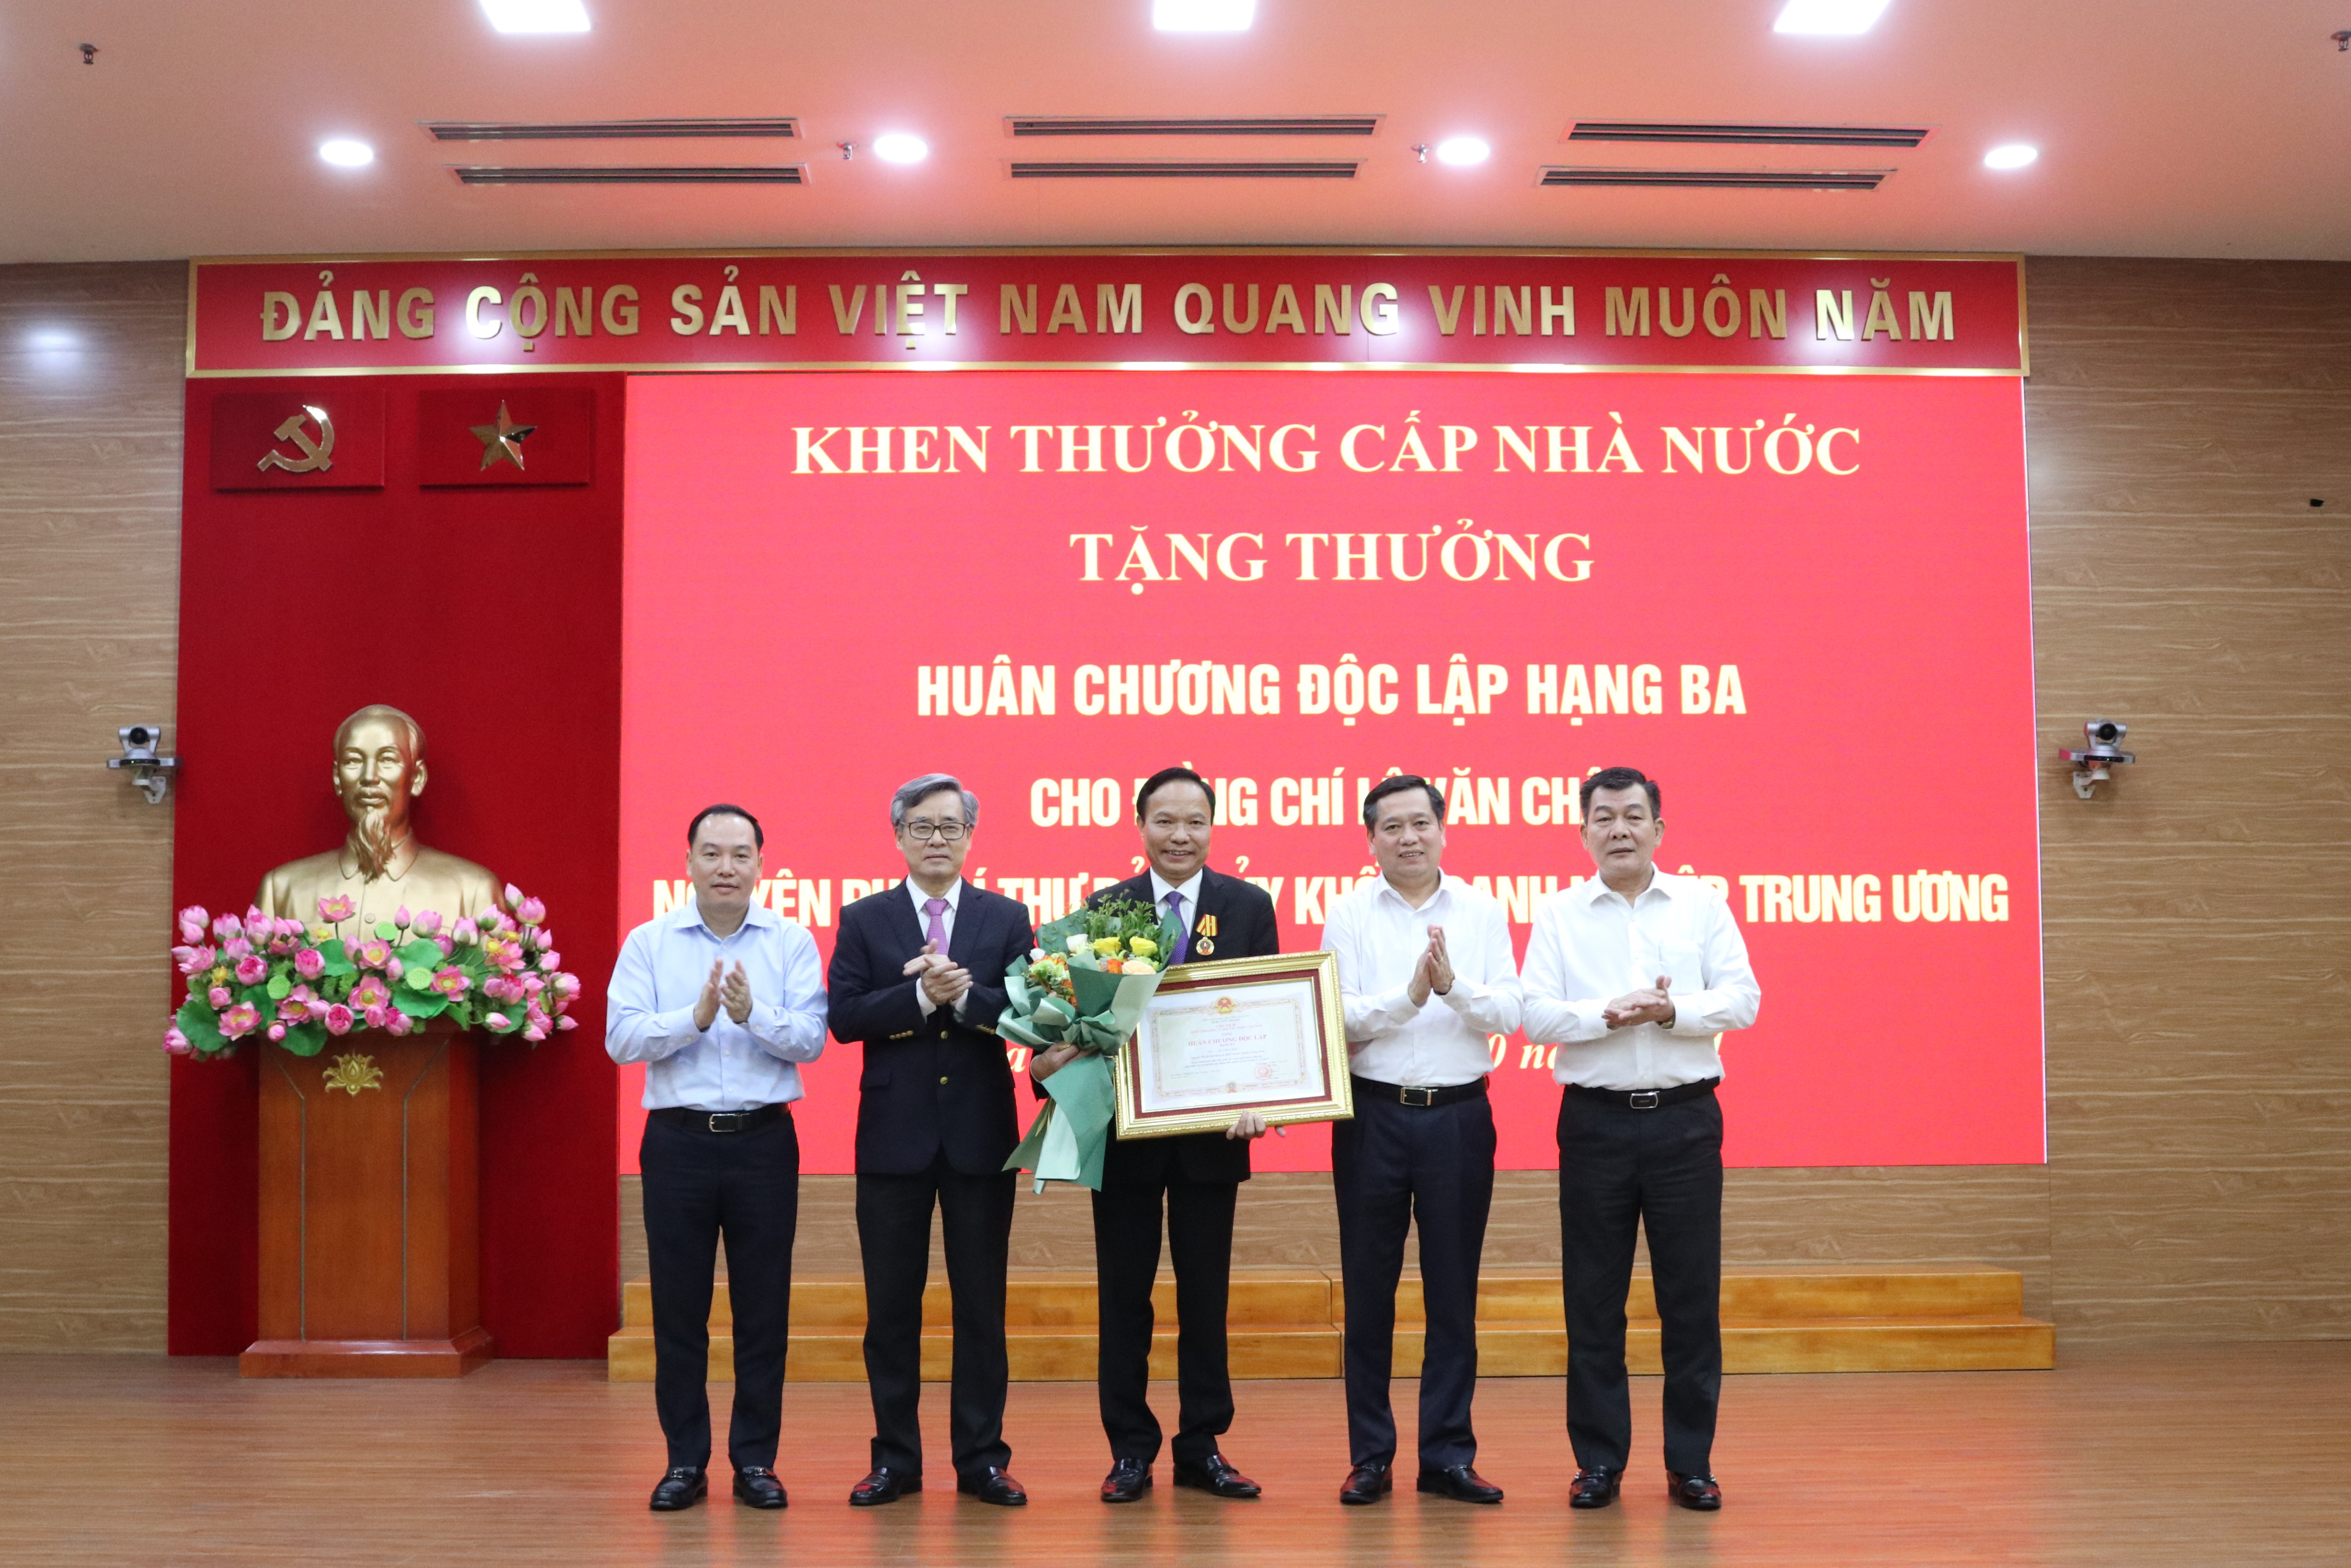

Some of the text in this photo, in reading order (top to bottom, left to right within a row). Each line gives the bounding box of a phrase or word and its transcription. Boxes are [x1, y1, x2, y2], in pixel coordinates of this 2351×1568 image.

[260, 265, 1954, 351] ĐẢNG CỘNG SẢN VIỆT NAM QUANG VINH MUÔN NĂM
[791, 410, 1859, 475] KHEN THƯỞNG CẤP NHÀ NƯỚC
[1070, 519, 1594, 595] TẶNG THƯỞNG
[918, 653, 1747, 726] HUÂN CHƯƠNG ĐỘC LẬP HẠNG BA
[1031, 778, 1121, 827] CHO
[1270, 767, 1344, 826] CHÍ
[1739, 874, 1881, 923] TRUNG
[1893, 870, 2008, 923] ƯƠNG
